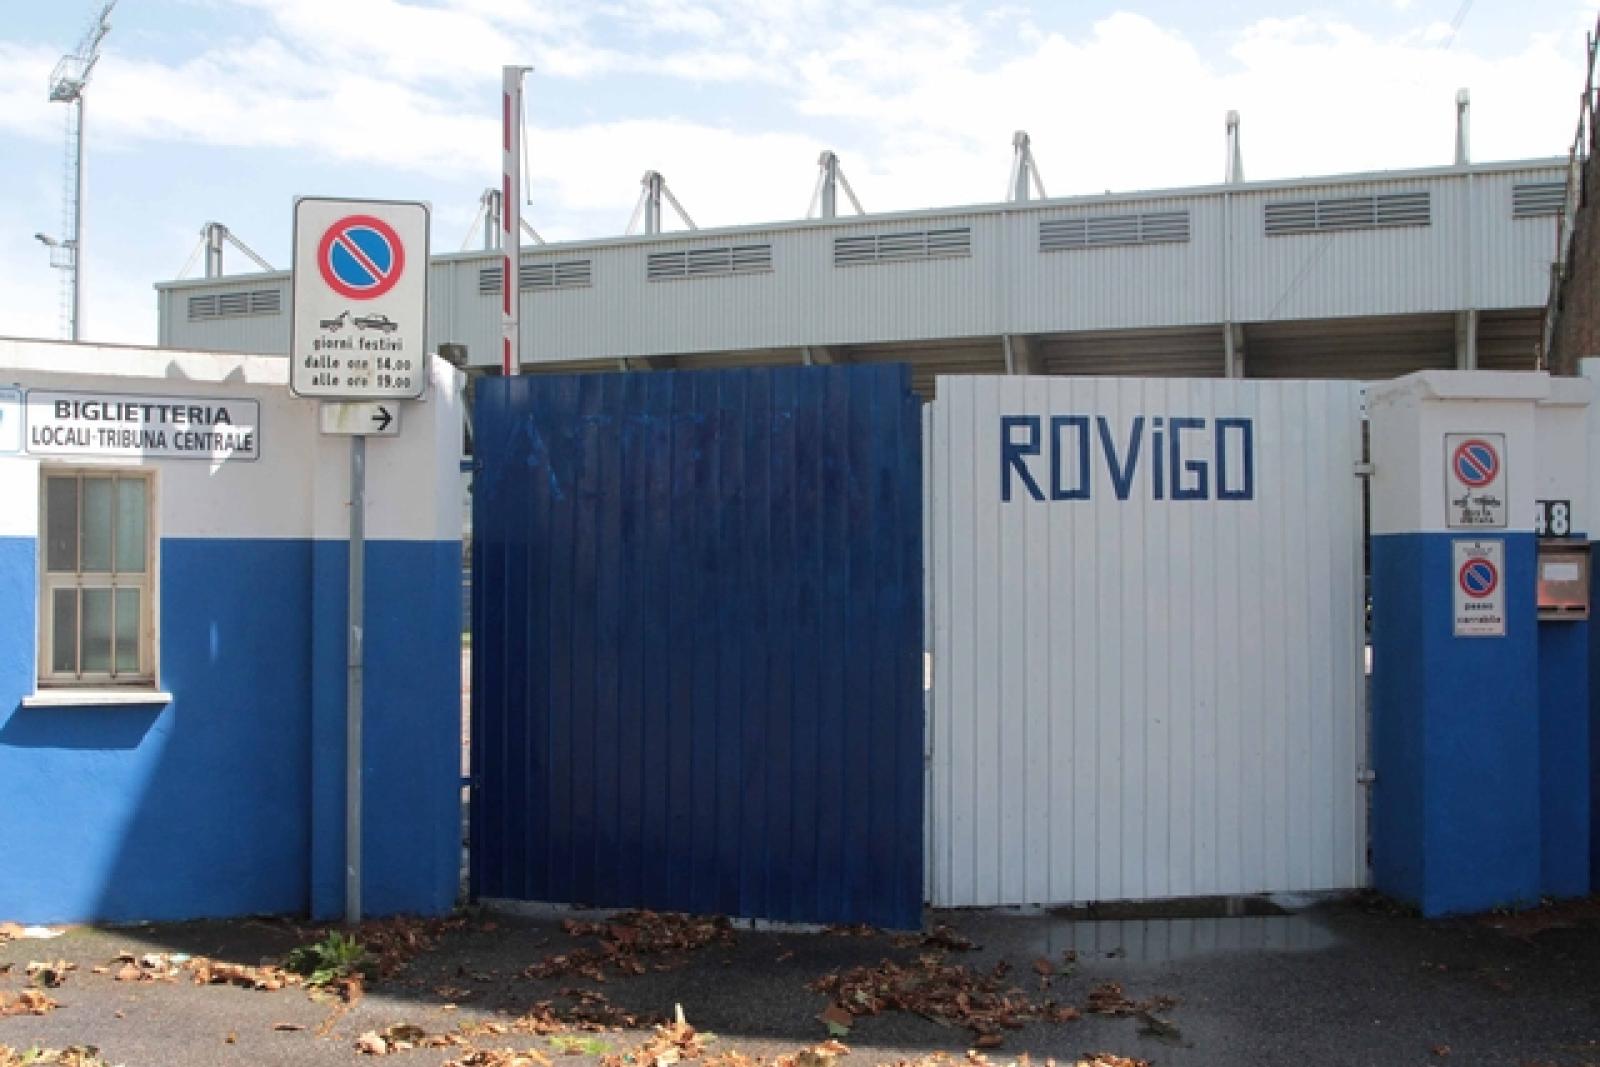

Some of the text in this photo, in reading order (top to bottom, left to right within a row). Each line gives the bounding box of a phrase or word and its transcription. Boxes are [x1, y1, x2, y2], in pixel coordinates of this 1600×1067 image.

[312, 335, 403, 351] giorni festivi
[304, 355, 339, 369] dalle
[347, 359, 368, 369] ore
[311, 372, 339, 386] alle
[347, 377, 368, 387] ore
[54, 400, 231, 425] BIGLIETTERIA
[174, 431, 253, 451] CENTRALE
